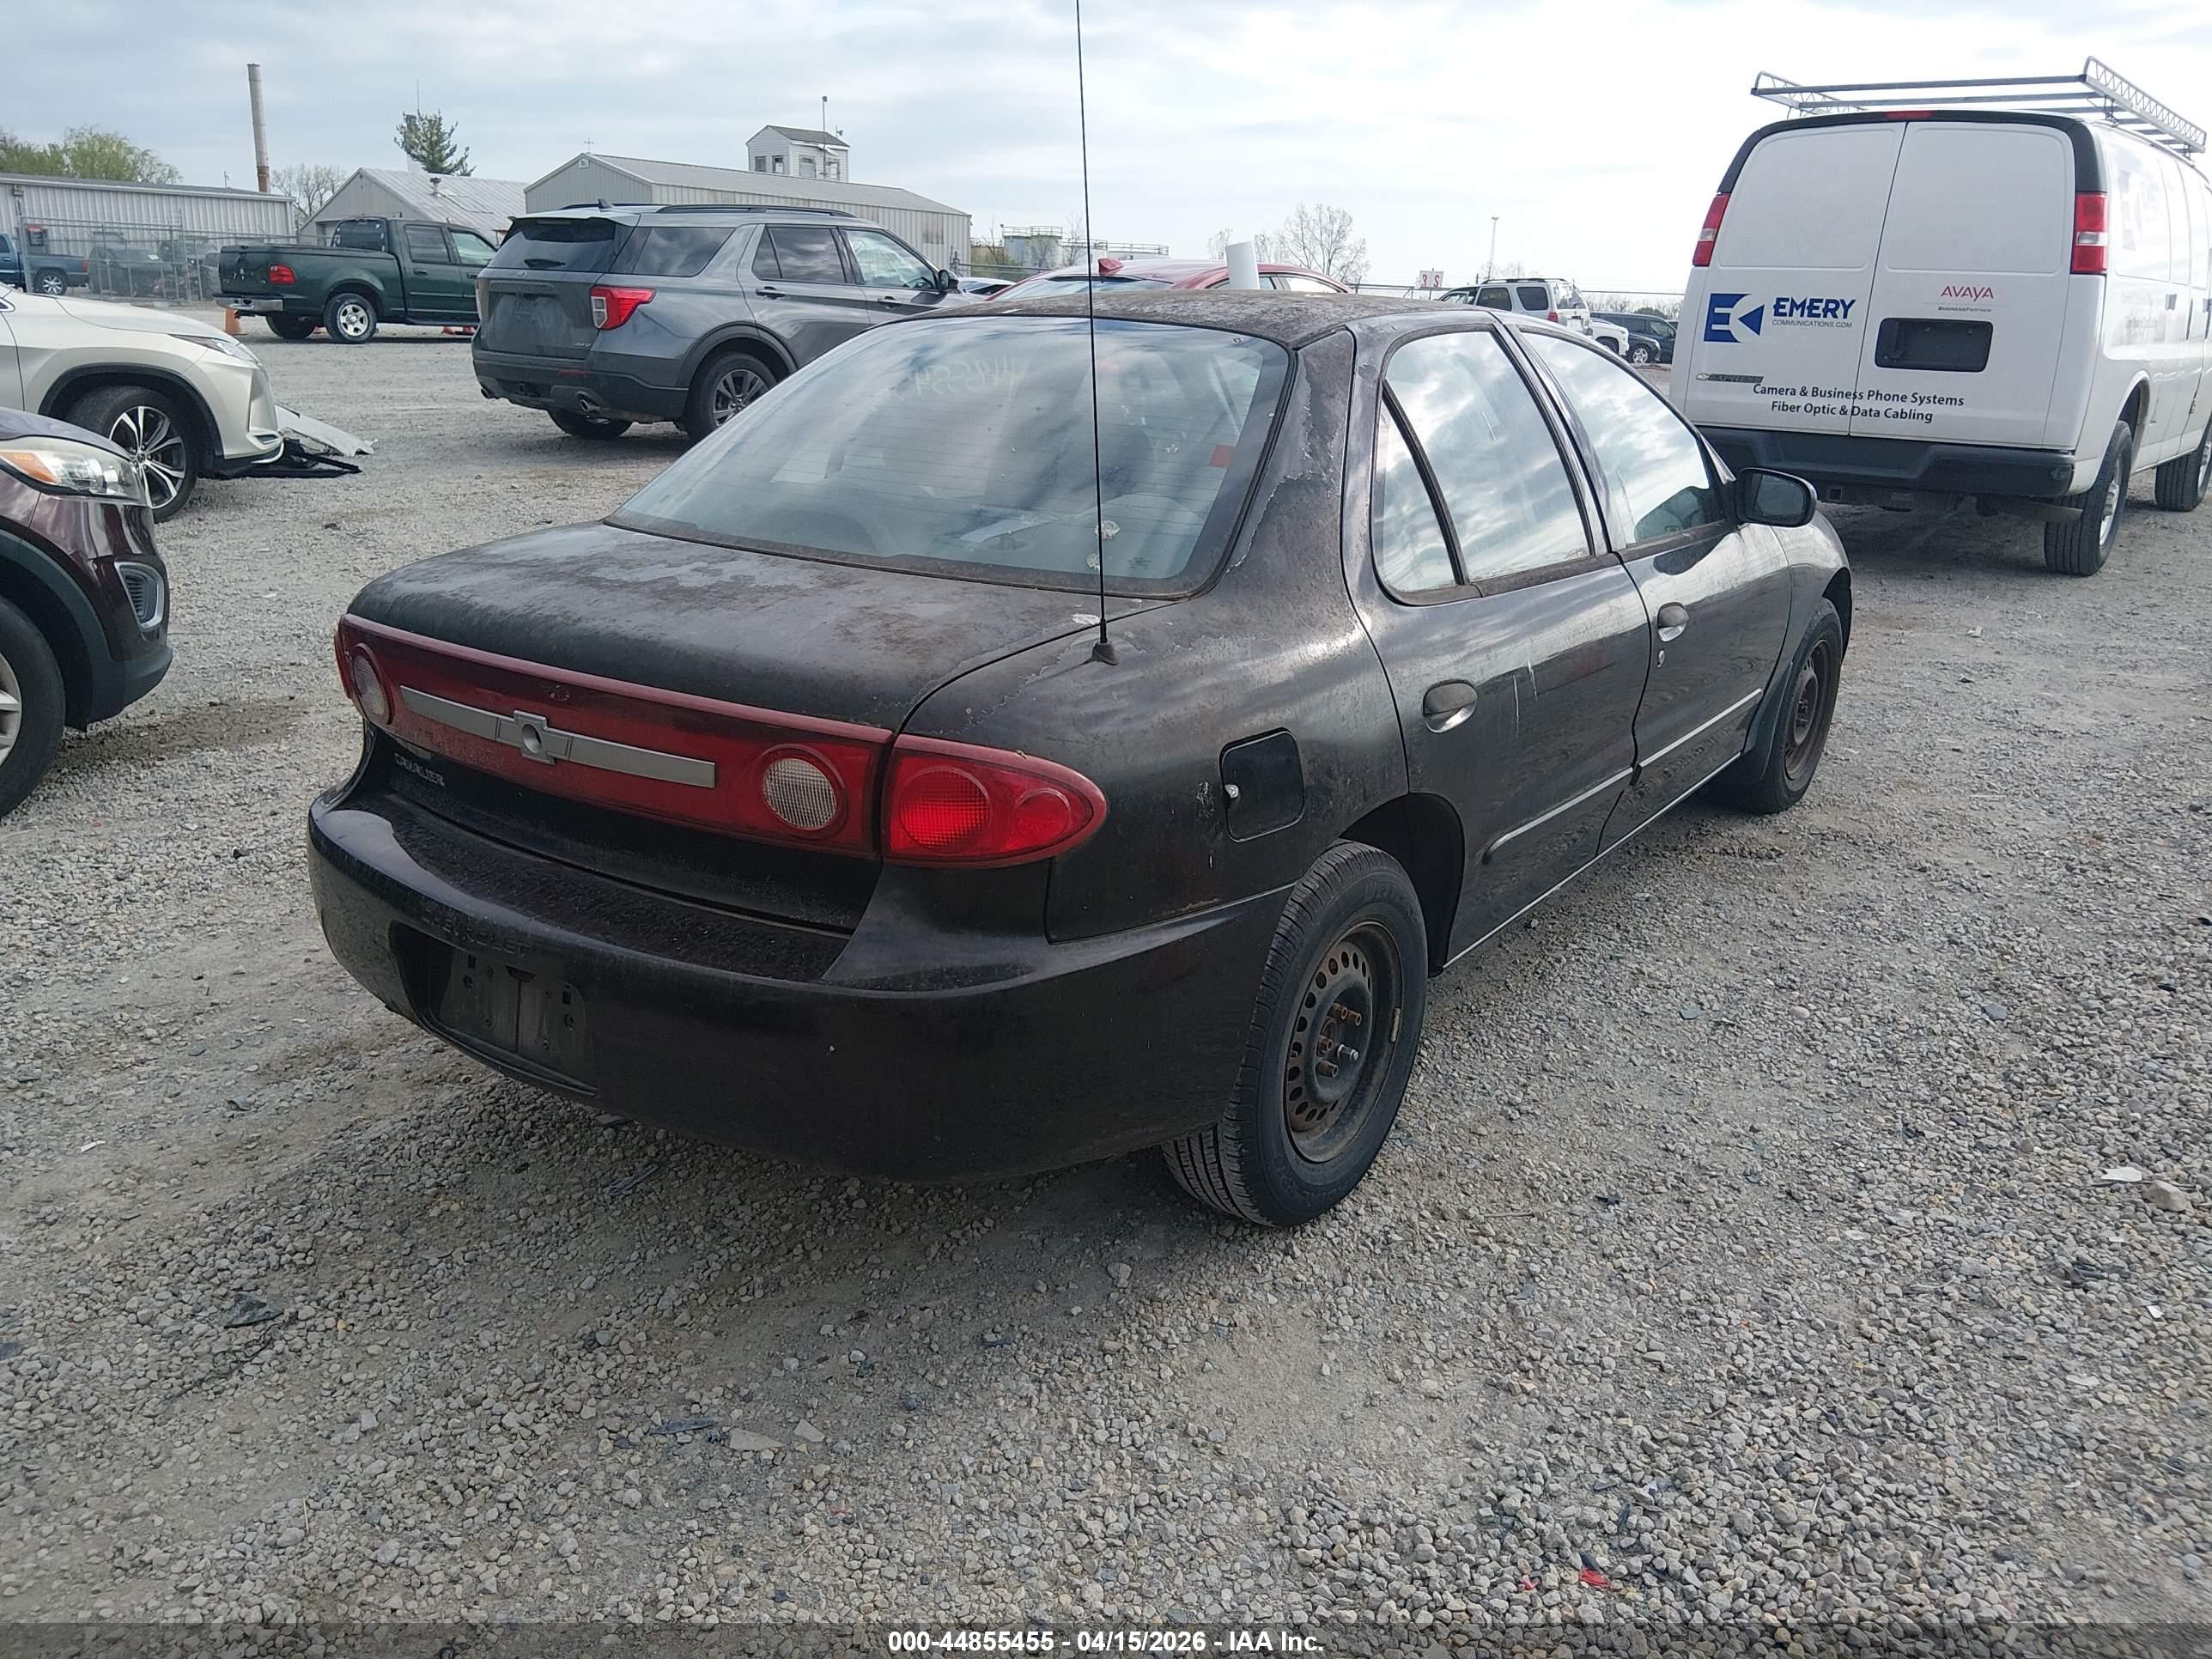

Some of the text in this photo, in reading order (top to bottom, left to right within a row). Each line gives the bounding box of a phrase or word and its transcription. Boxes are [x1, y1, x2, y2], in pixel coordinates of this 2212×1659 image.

[1941, 286, 1994, 302] AVAYA
[1772, 296, 1856, 319] EMERY
[1772, 319, 1853, 328] COMMUNICATIONS.COM
[1709, 374, 1764, 384] EXPRESS
[1753, 383, 1965, 406] Camera & Business Phone Systems
[1771, 400, 1934, 423] Fiber Optic & Data Cabling
[393, 752, 446, 787] CAVALIER
